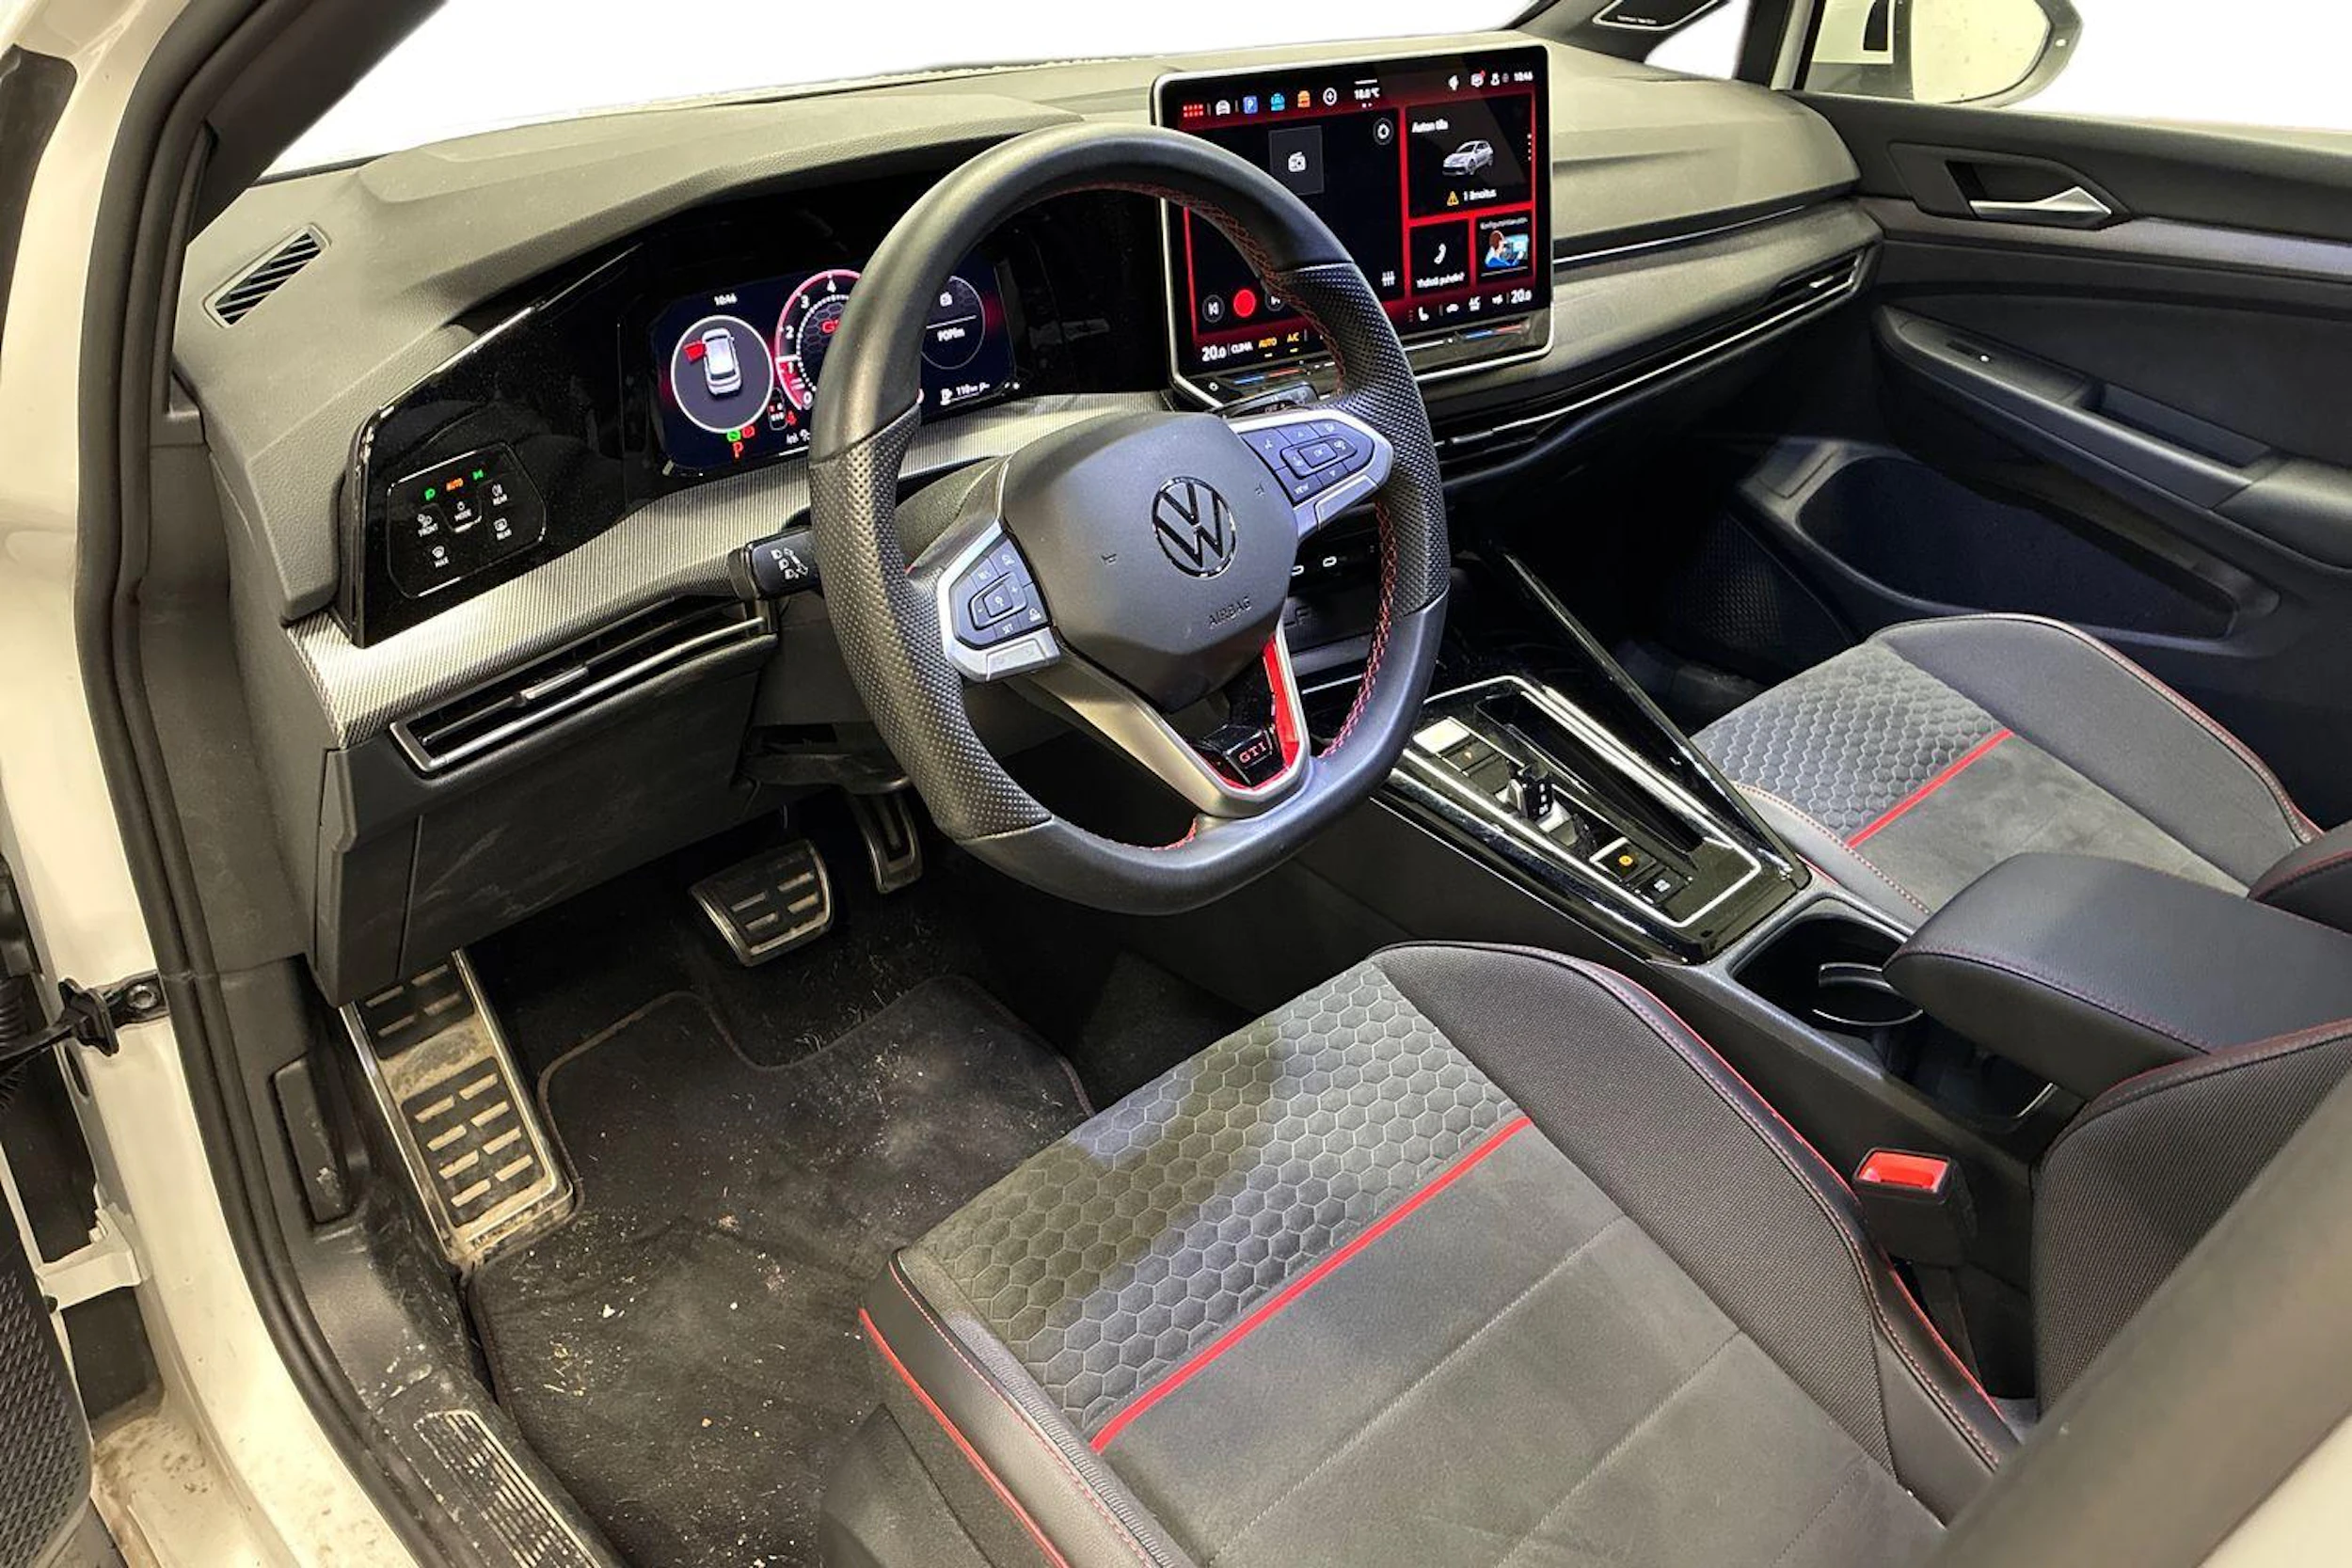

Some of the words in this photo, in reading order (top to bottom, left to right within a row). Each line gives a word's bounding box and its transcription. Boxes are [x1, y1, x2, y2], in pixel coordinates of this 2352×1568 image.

[827, 279, 836, 293] 4
[801, 294, 809, 309] 3
[1511, 288, 1533, 304] 20.0
[786, 325, 794, 339] 2
[1259, 337, 1278, 348] AUTO
[1202, 343, 1227, 361] 20.0
[803, 390, 813, 404] 0
[732, 441, 744, 459] P
[446, 478, 463, 492] AUTO
[1208, 595, 1251, 626] AIRBAG
[1239, 741, 1266, 763] GTI
